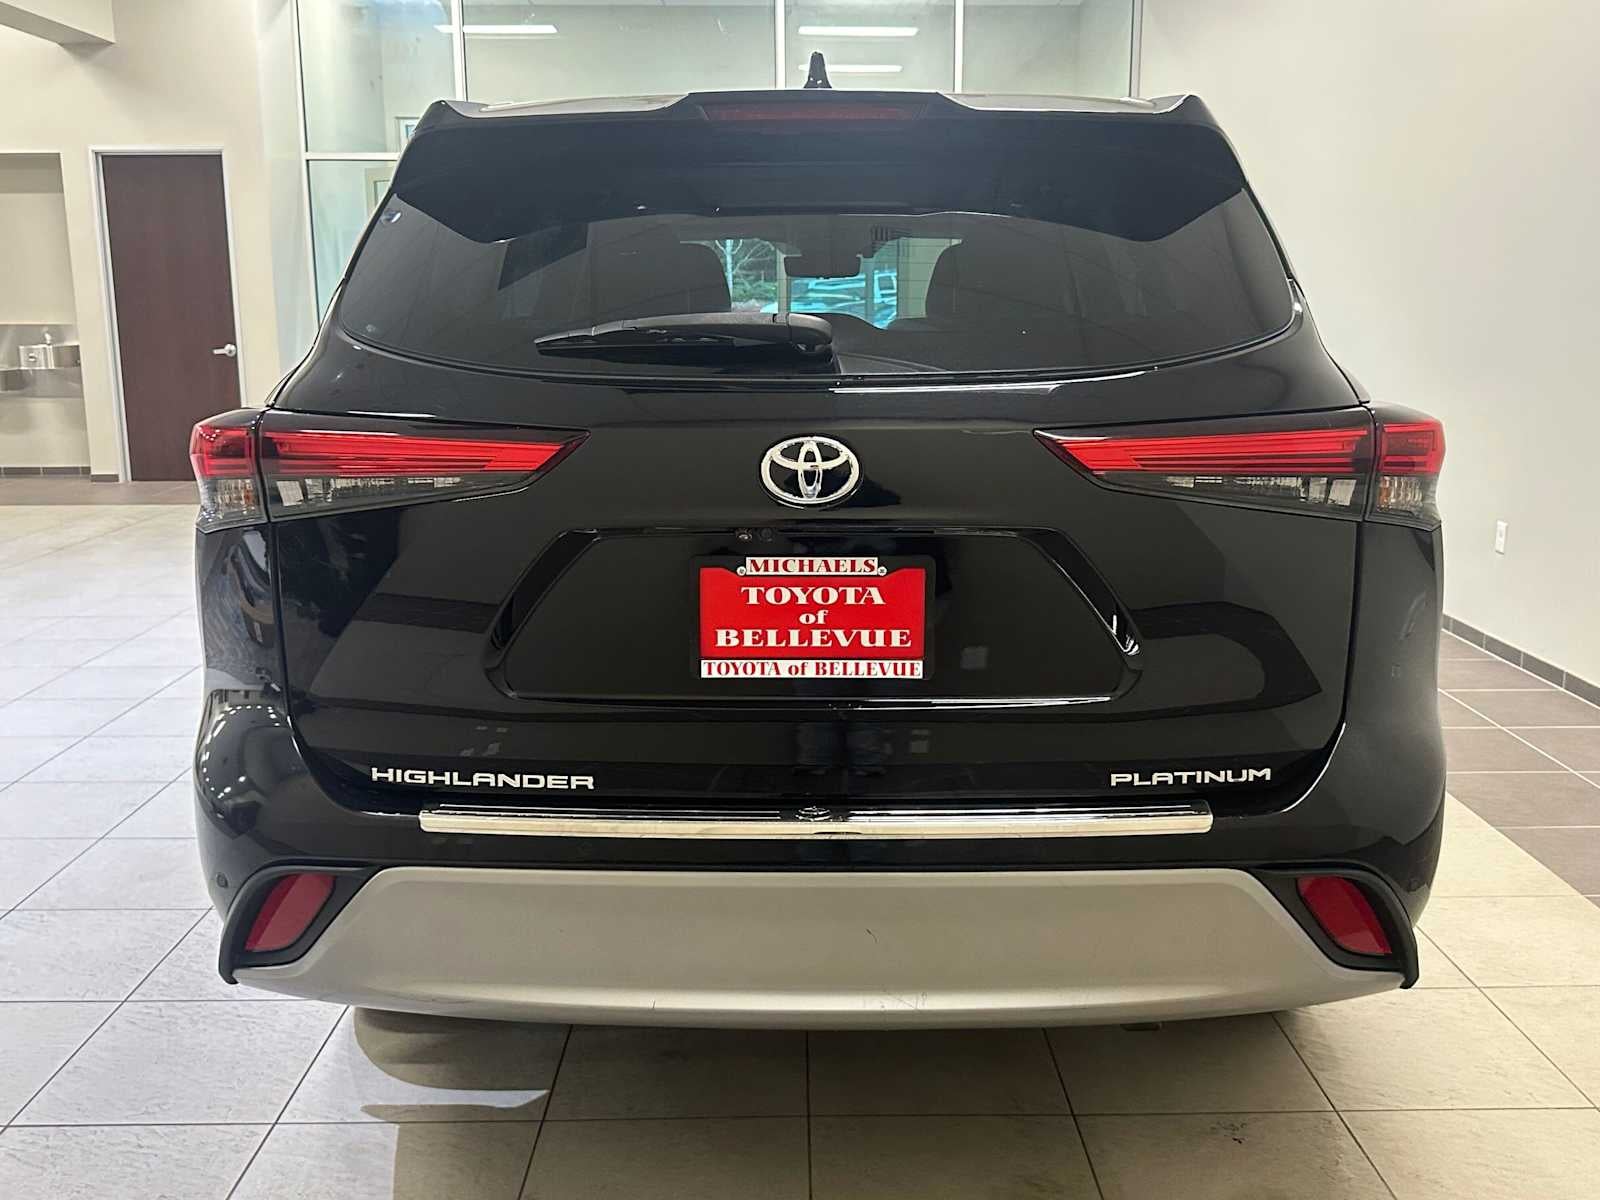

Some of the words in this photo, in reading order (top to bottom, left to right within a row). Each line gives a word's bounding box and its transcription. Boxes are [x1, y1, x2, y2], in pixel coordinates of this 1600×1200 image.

[749, 559, 876, 573] MICHAELS
[741, 586, 886, 605] TOYOTA
[799, 609, 829, 625] of
[715, 629, 912, 647] BELLEVUE
[703, 661, 780, 676] TOYOTA
[788, 661, 808, 676] of
[815, 661, 921, 677] BELLEVUE
[371, 767, 595, 790] HIGHLANDER
[1110, 768, 1272, 787] PLATINUM
